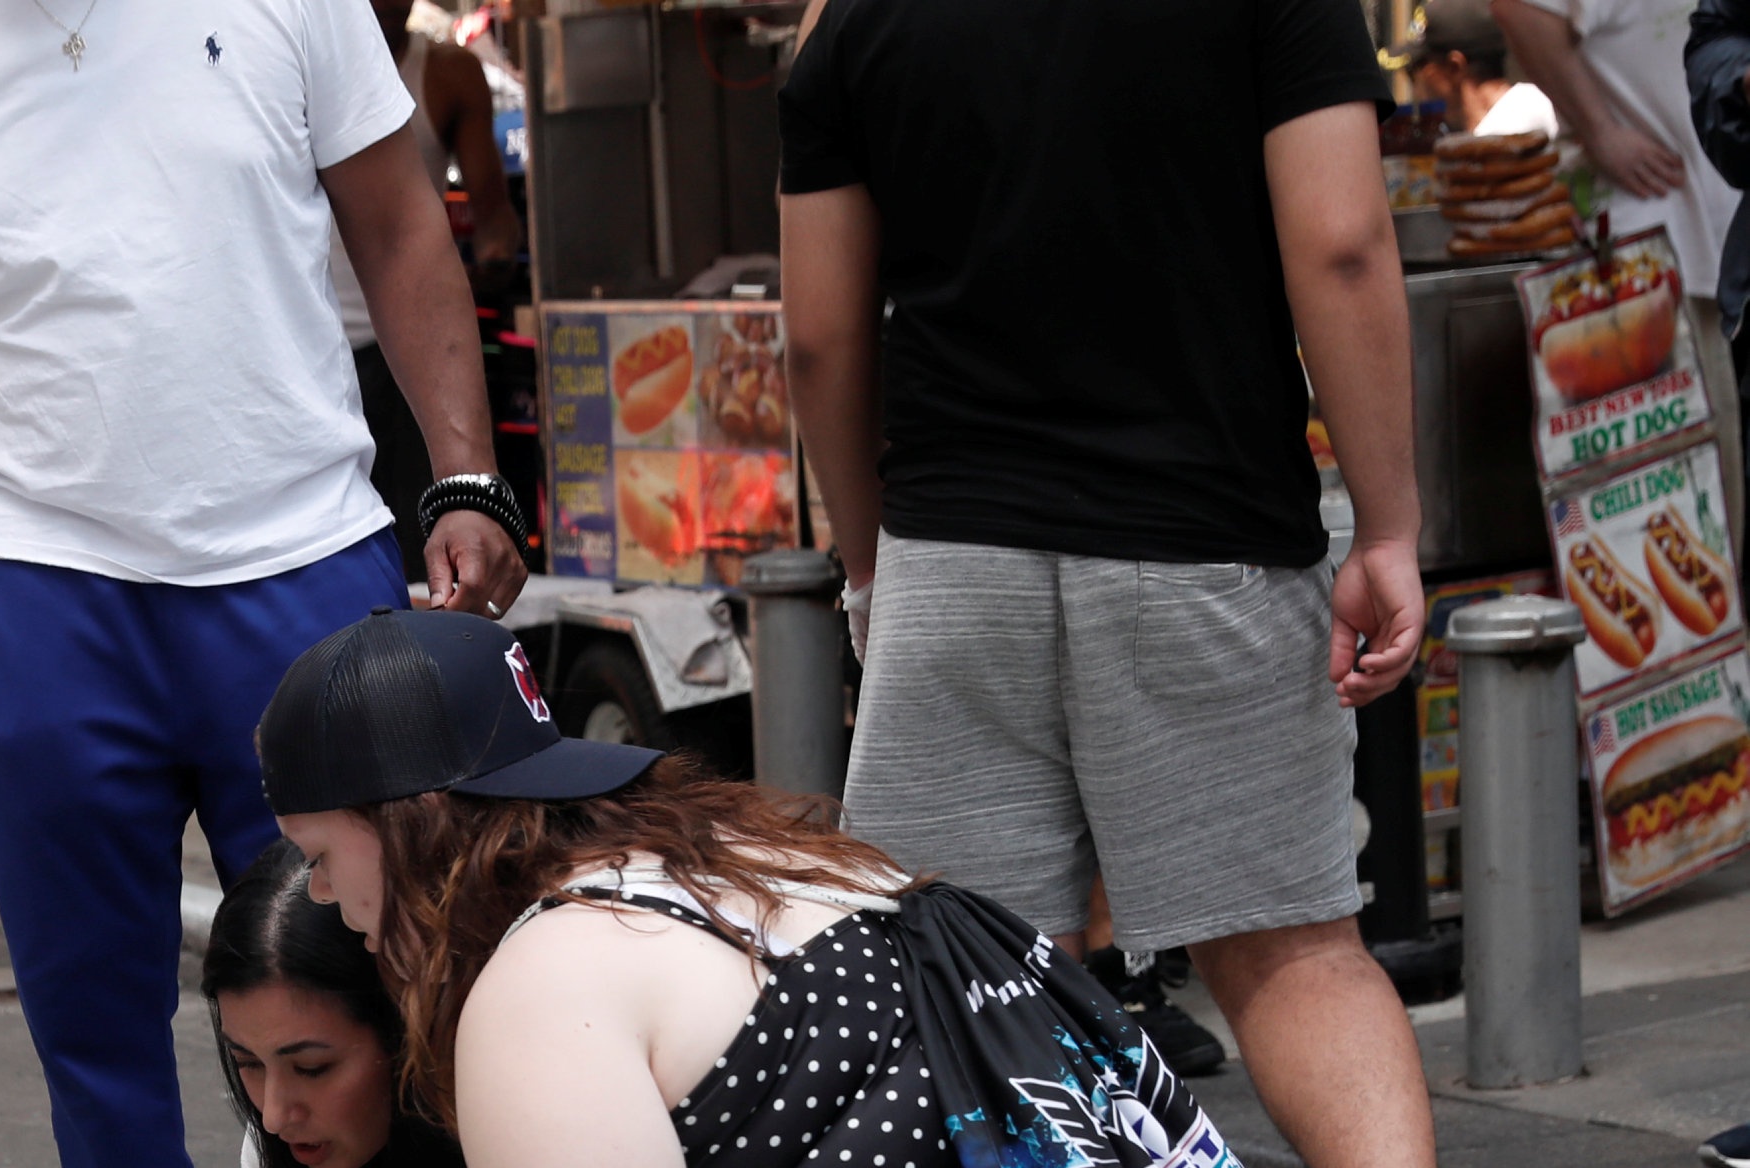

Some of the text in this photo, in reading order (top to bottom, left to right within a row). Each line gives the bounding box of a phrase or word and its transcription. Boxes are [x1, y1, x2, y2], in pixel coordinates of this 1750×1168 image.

[1550, 404, 1599, 437] BEST
[1604, 386, 1646, 417] NEW
[1571, 397, 1688, 462] HOT DOG
[1590, 460, 1685, 522] CHILI DOG
